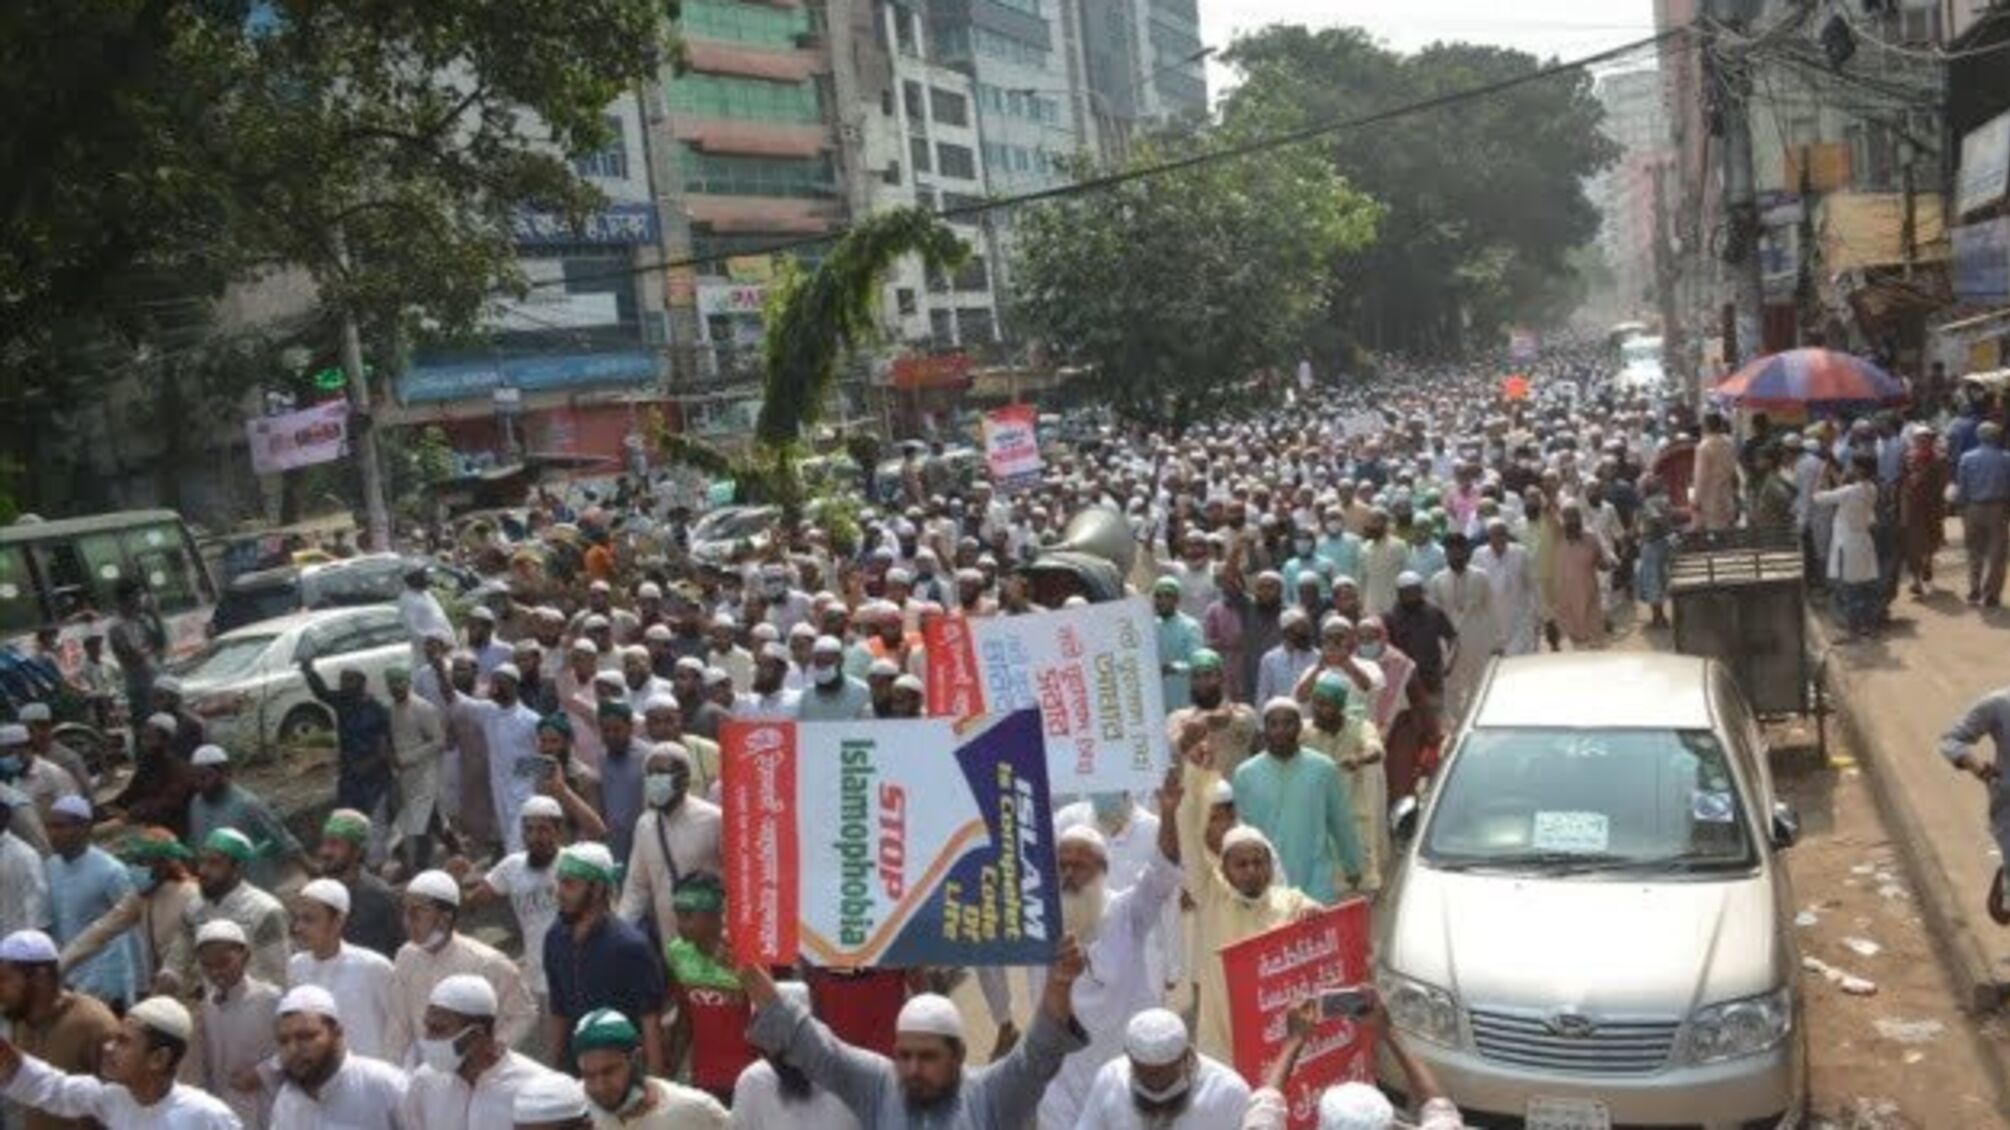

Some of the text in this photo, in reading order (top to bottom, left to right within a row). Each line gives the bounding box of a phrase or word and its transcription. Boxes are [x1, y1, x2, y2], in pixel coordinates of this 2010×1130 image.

[834, 738, 876, 945] Islamophobia
[878, 781, 907, 902] STOP
[981, 866, 999, 941] Code
[1013, 777, 1048, 942] ISLAM
